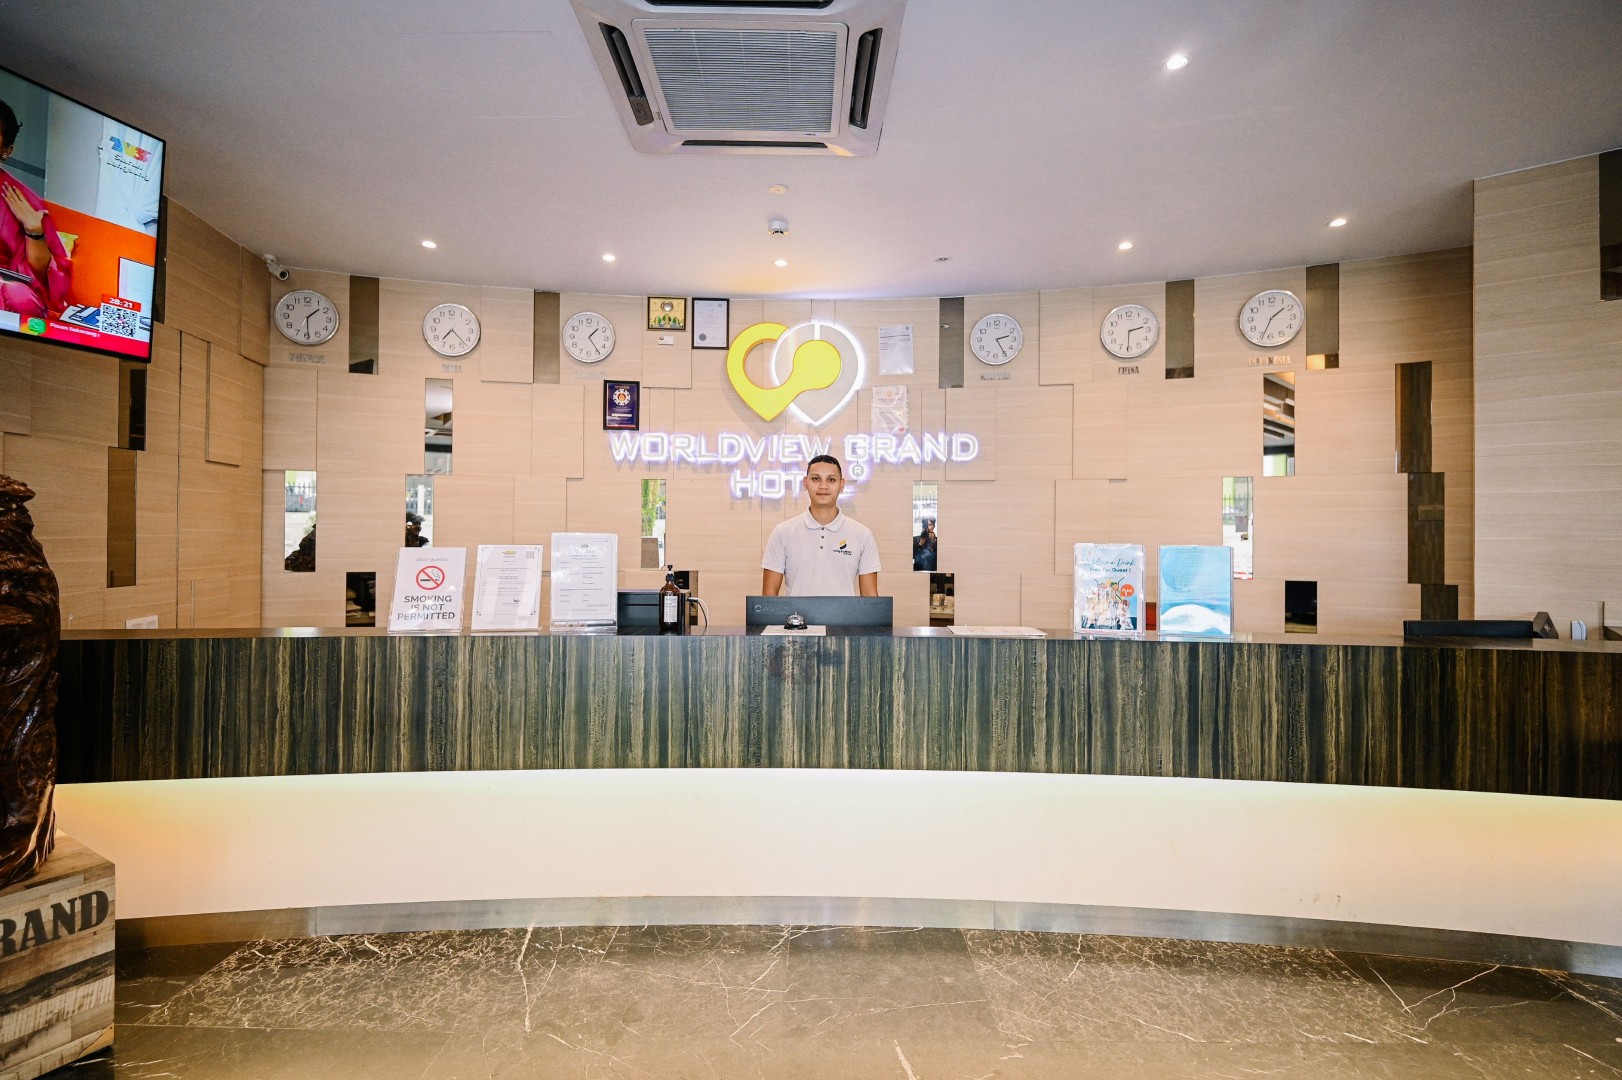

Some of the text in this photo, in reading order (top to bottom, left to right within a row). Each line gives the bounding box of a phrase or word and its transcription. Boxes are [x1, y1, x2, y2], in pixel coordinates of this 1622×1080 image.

[294, 296, 300, 304] 11
[1118, 366, 1140, 374] CHINA
[610, 433, 979, 463] WORLDVIEW GRAND
[397, 612, 456, 620] PERMITTED
